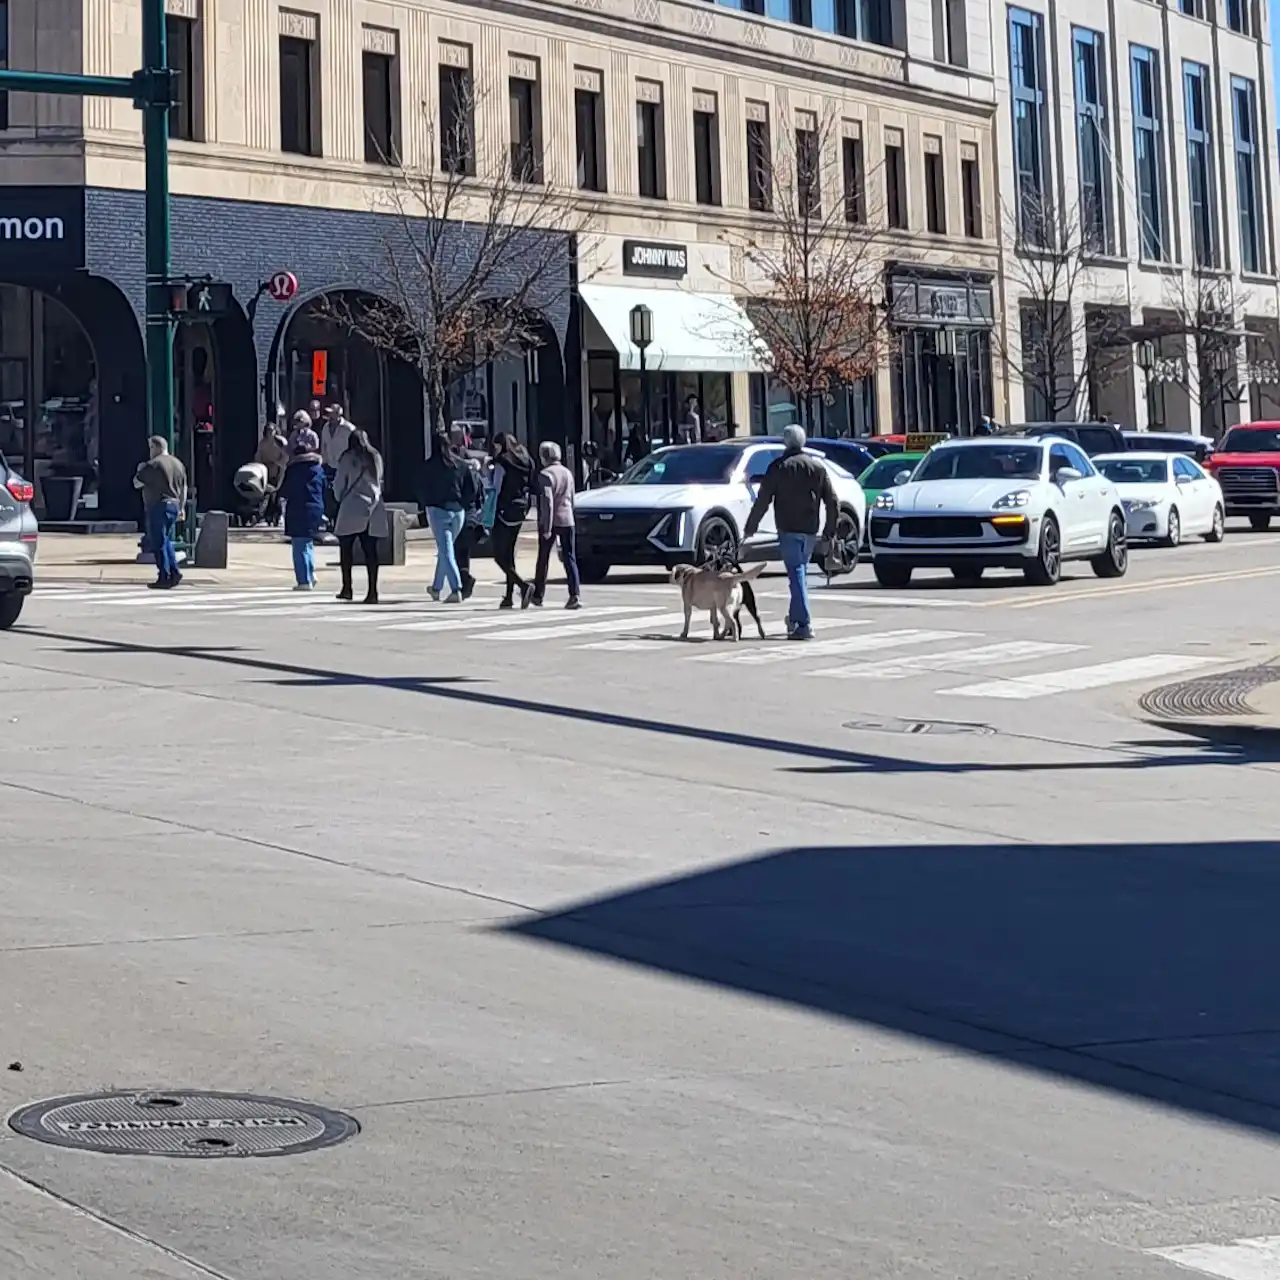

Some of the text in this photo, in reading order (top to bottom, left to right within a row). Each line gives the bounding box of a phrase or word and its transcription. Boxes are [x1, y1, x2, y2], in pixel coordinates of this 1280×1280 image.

[631, 246, 686, 268] JOHNNY WAS
[67, 1117, 299, 1130] COMMUNICATION
